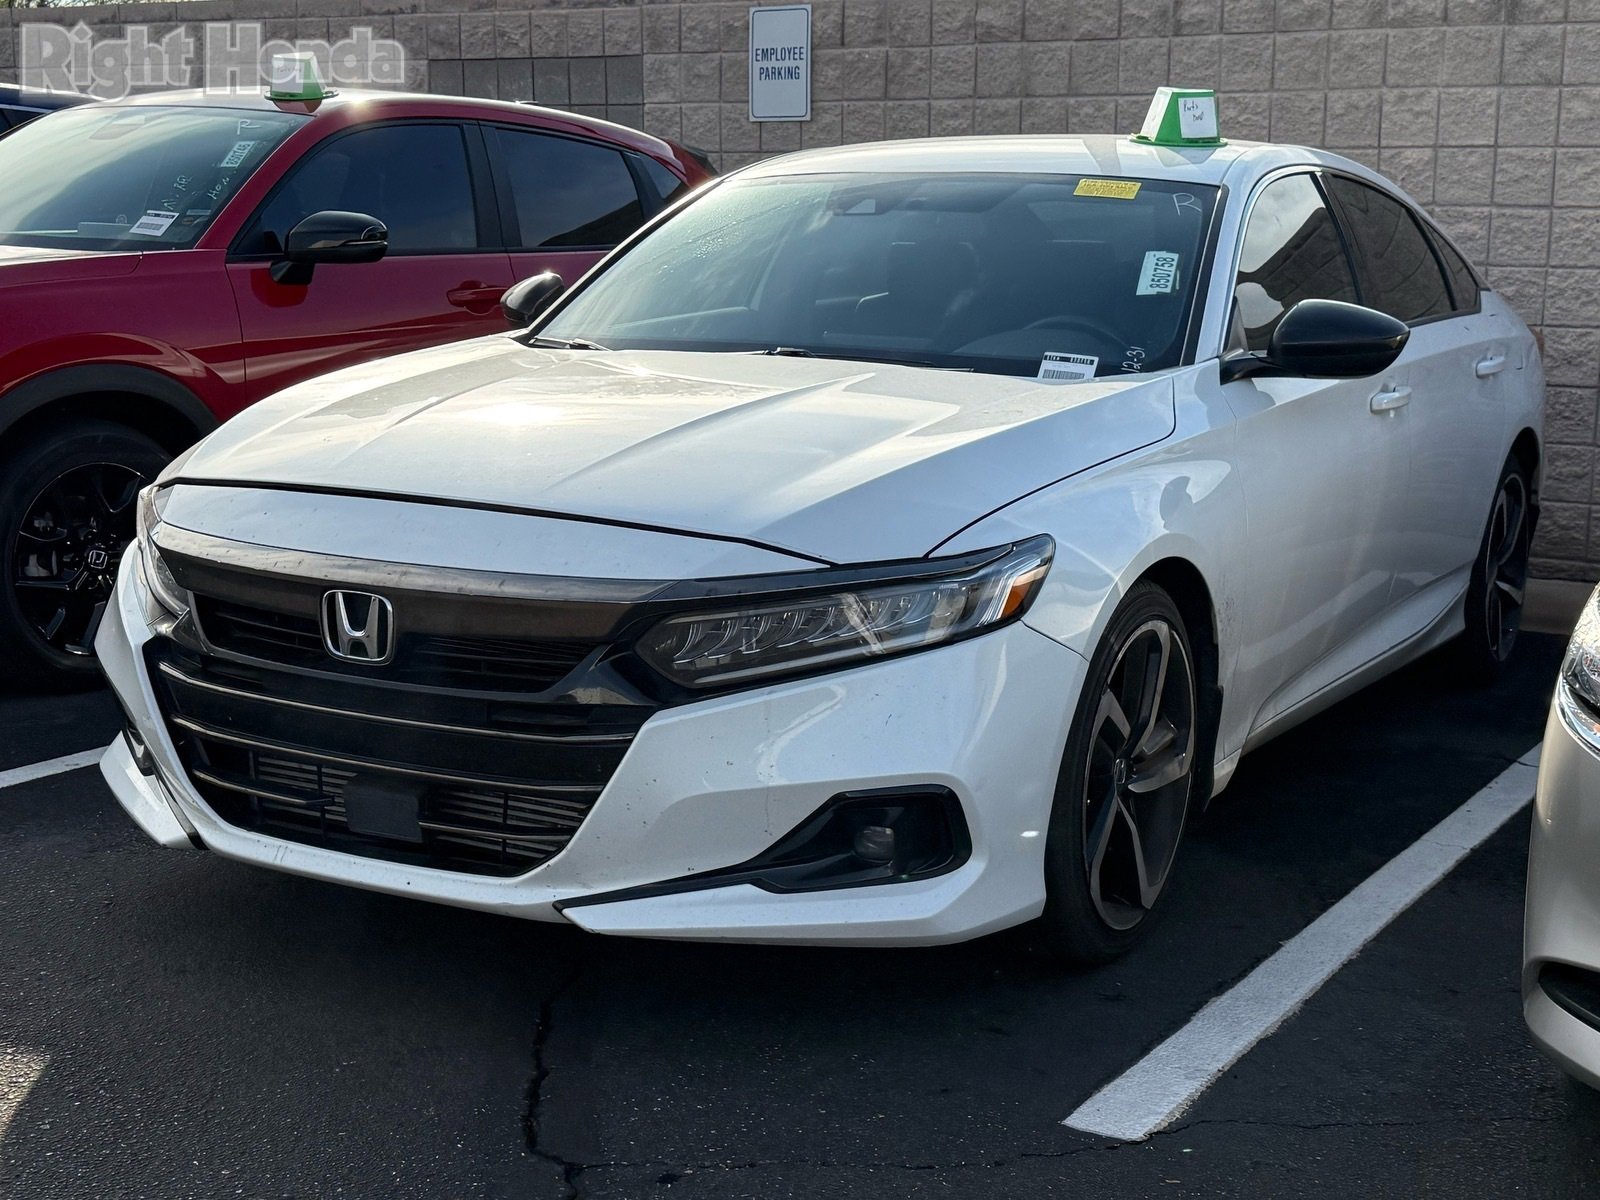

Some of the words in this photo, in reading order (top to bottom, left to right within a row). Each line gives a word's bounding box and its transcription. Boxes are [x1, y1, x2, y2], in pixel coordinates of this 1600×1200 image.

[755, 46, 805, 62] EMPLOYEE
[759, 65, 801, 81] PARKING
[237, 118, 262, 135] R
[1172, 192, 1202, 216] R
[1149, 256, 1175, 289] 850758
